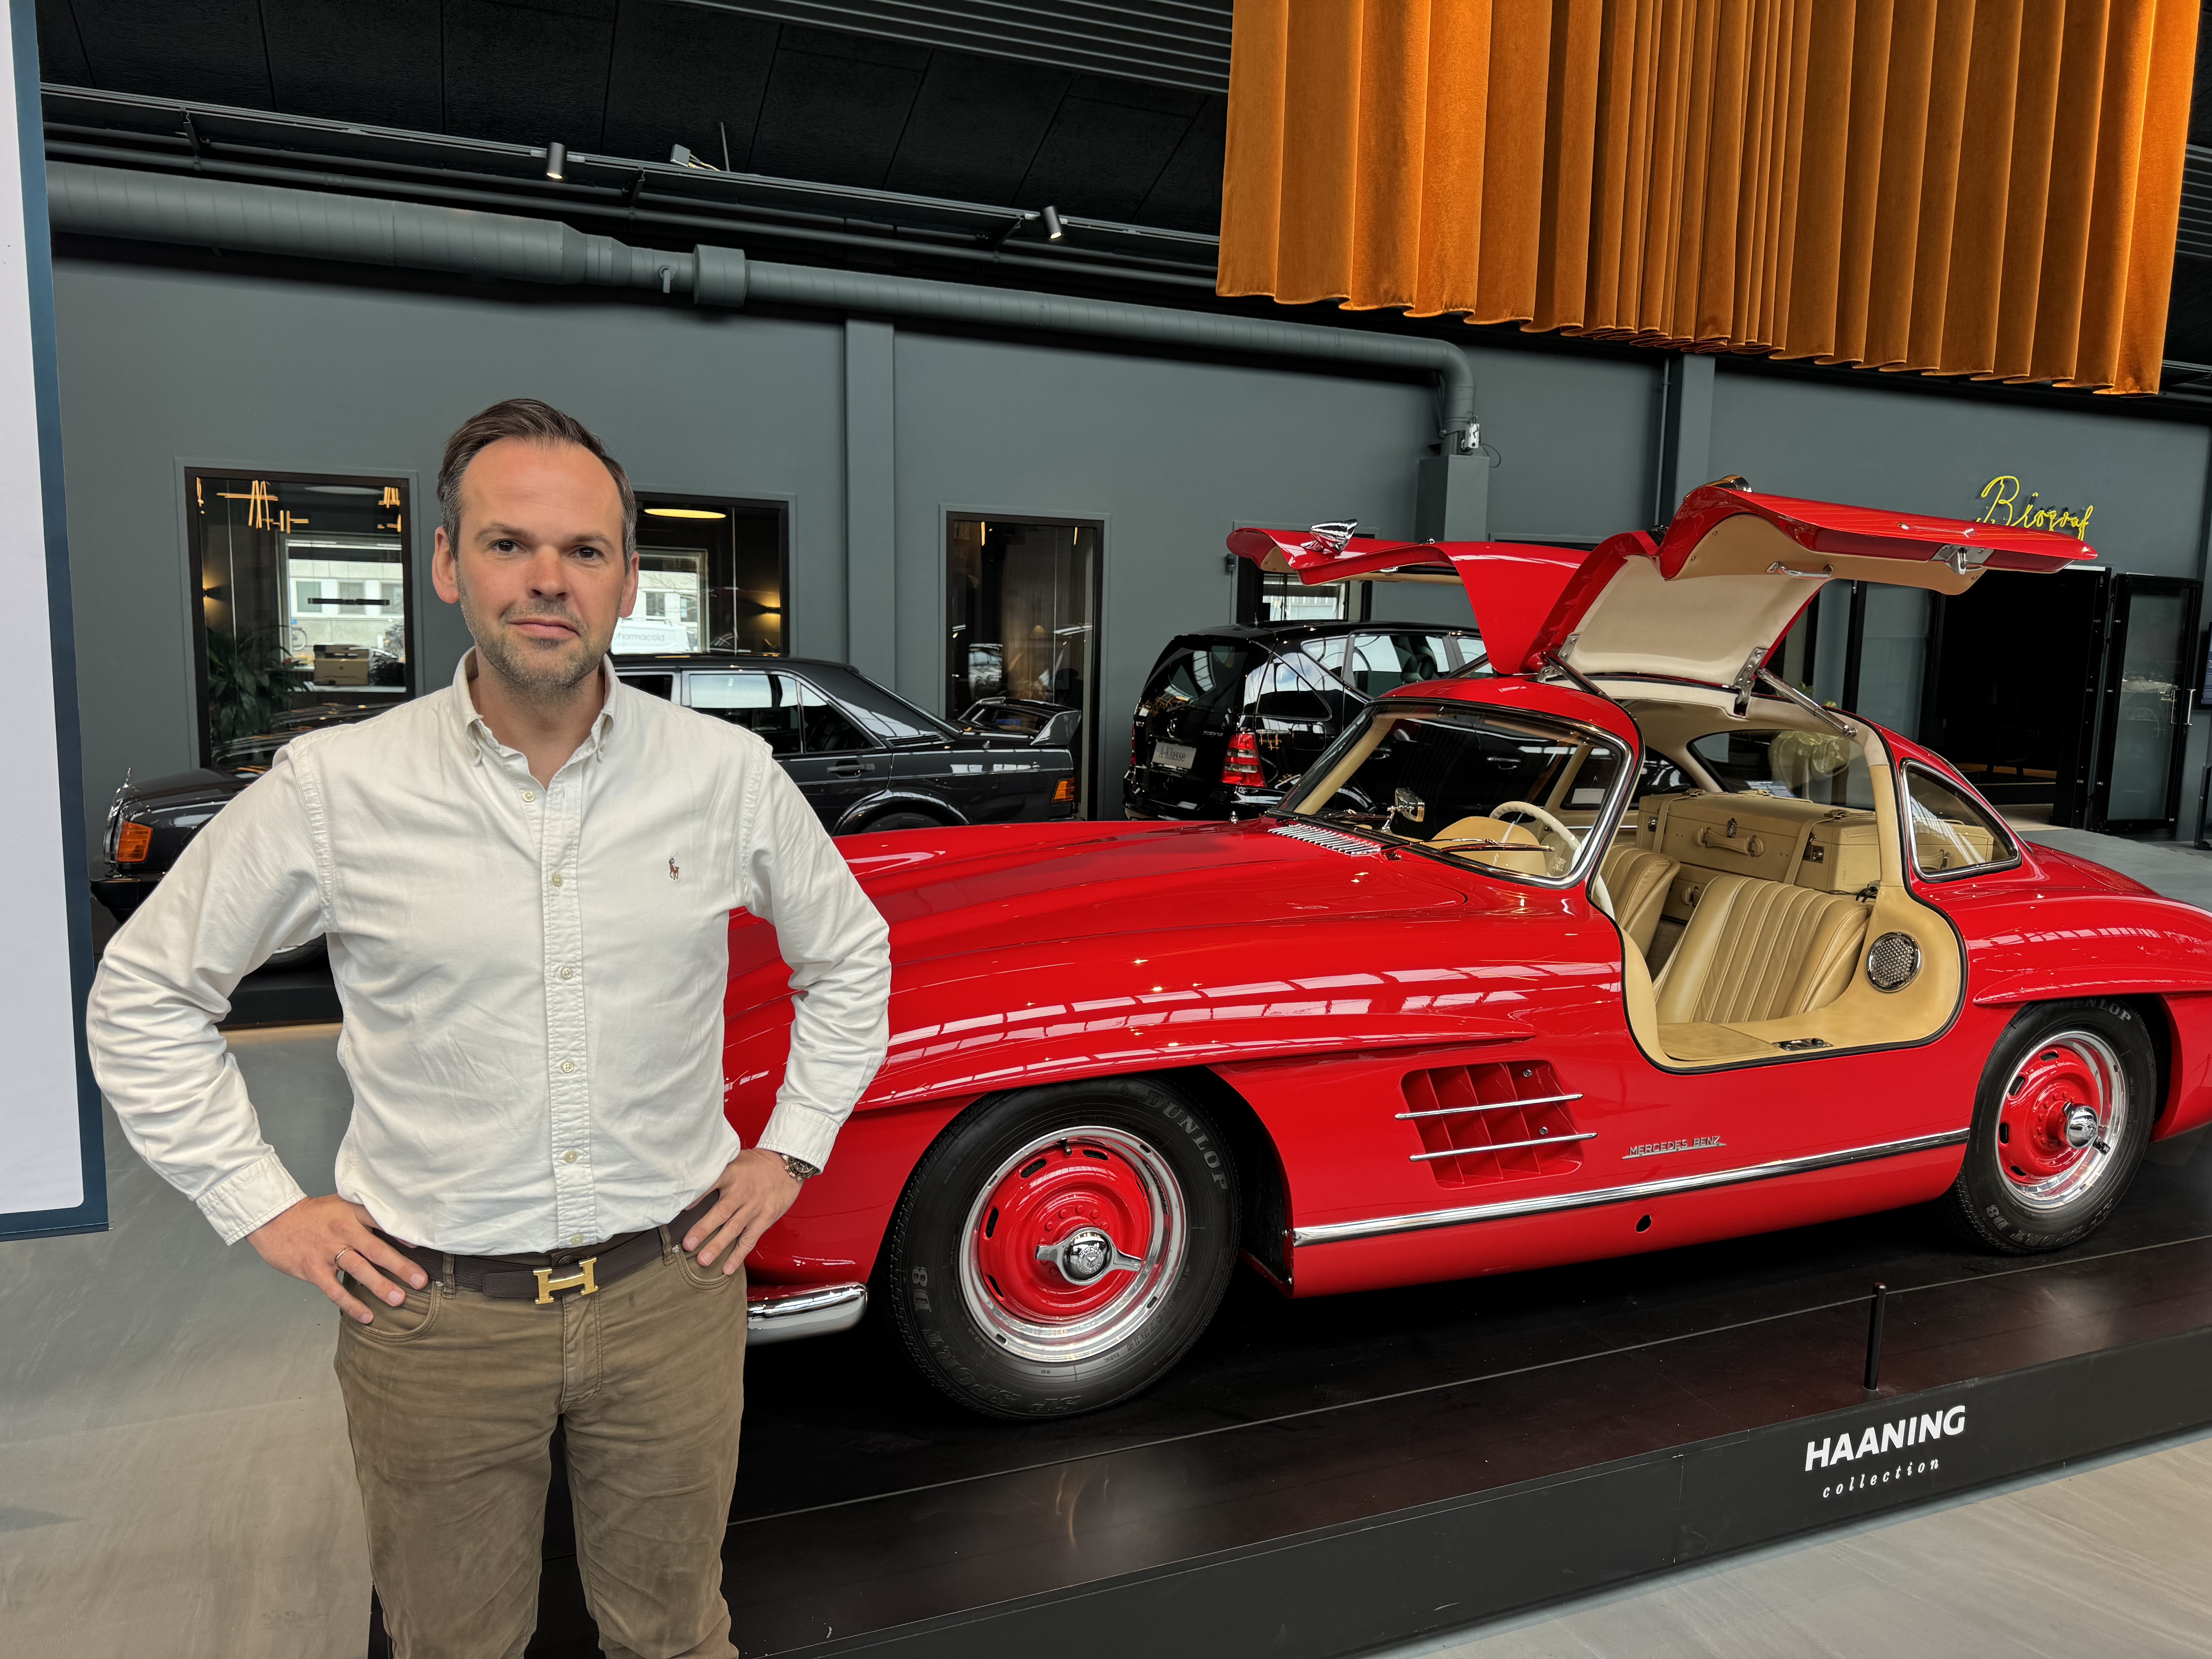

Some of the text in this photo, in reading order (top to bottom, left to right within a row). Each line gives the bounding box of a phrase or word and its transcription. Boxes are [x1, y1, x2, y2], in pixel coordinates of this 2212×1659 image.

[1976, 476, 2094, 541] Biograf
[1158, 747, 1185, 762] A-Klasse
[1140, 1090, 1228, 1190] DUNLOP
[1629, 1135, 1721, 1156] MERCEDES BENZ
[1985, 1205, 2010, 1230] D8
[912, 1266, 932, 1312] D8
[921, 1329, 1021, 1407] SPORT
[1103, 1352, 1120, 1364] RADIAL
[1029, 1395, 1082, 1413] SP
[1805, 1405, 1966, 1472] HAANING
[1822, 1458, 1939, 1498] collection
